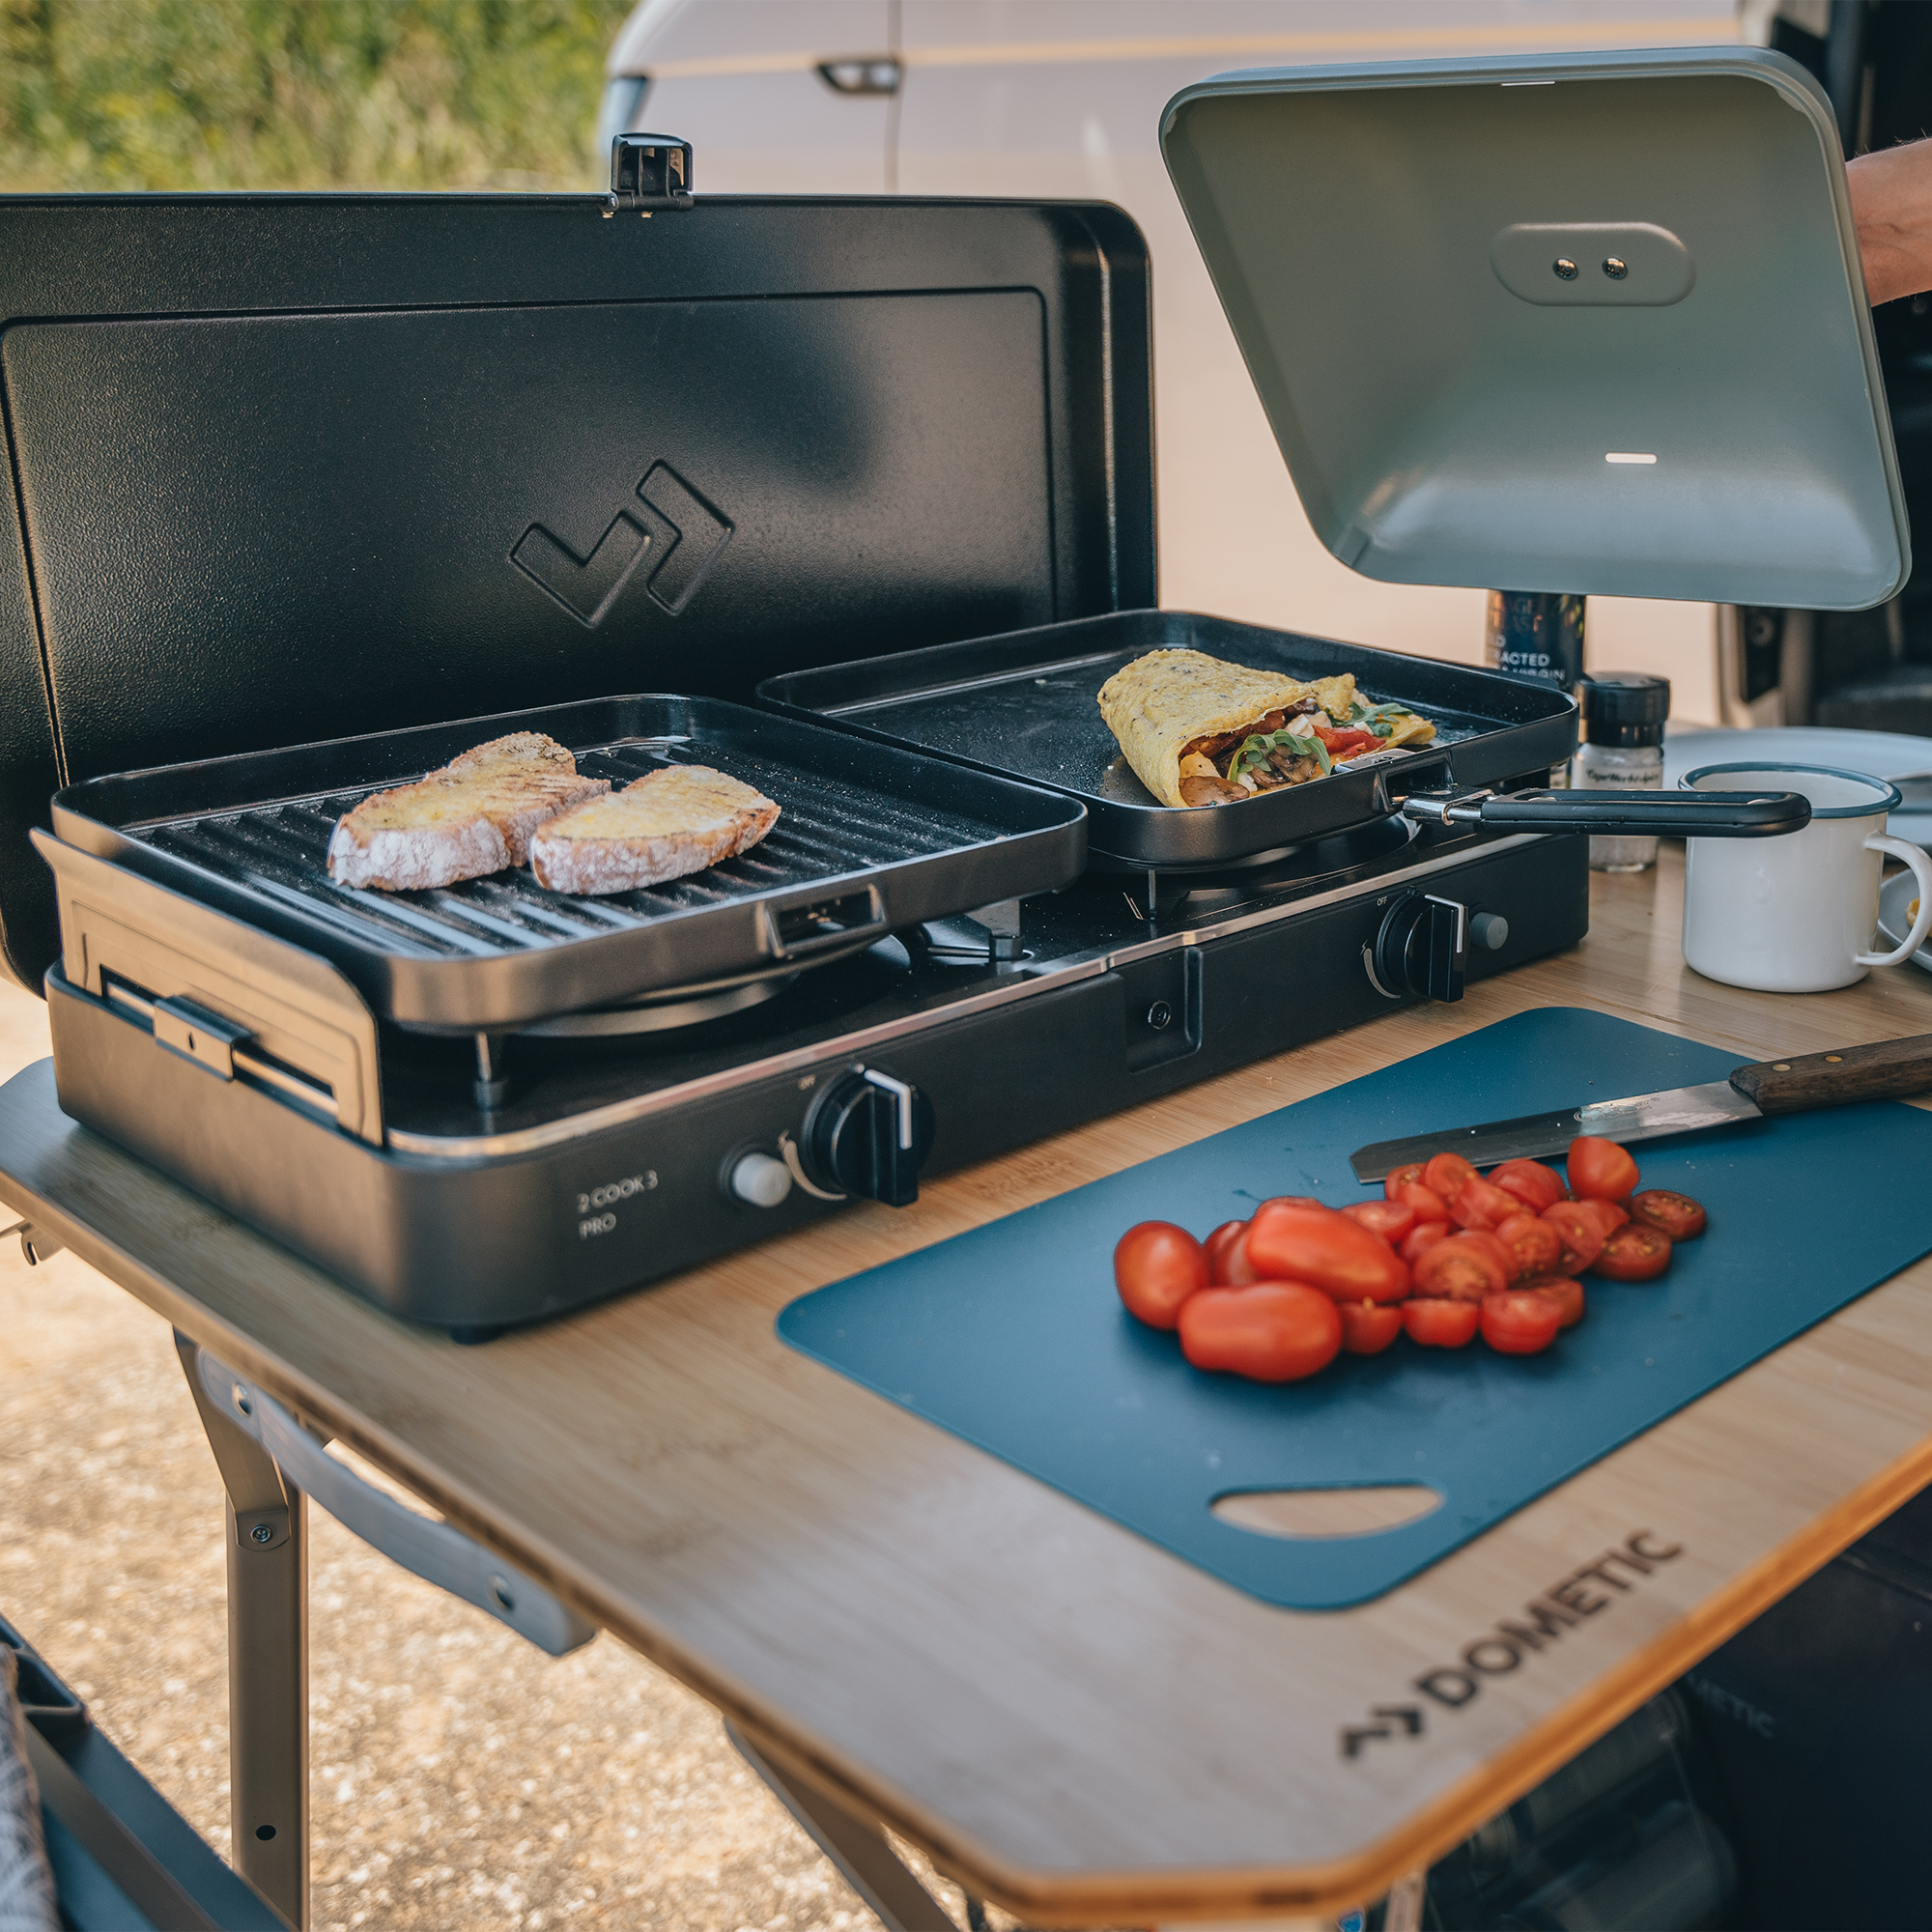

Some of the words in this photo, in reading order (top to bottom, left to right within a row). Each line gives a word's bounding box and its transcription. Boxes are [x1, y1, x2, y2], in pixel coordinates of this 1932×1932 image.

[1377, 896, 1387, 906] OFF
[577, 1192, 590, 1213] 2
[590, 1174, 645, 1208] COOK
[646, 1169, 659, 1190] 3
[579, 1212, 617, 1241] PRO
[1412, 1528, 1684, 1709] DOMETIC
